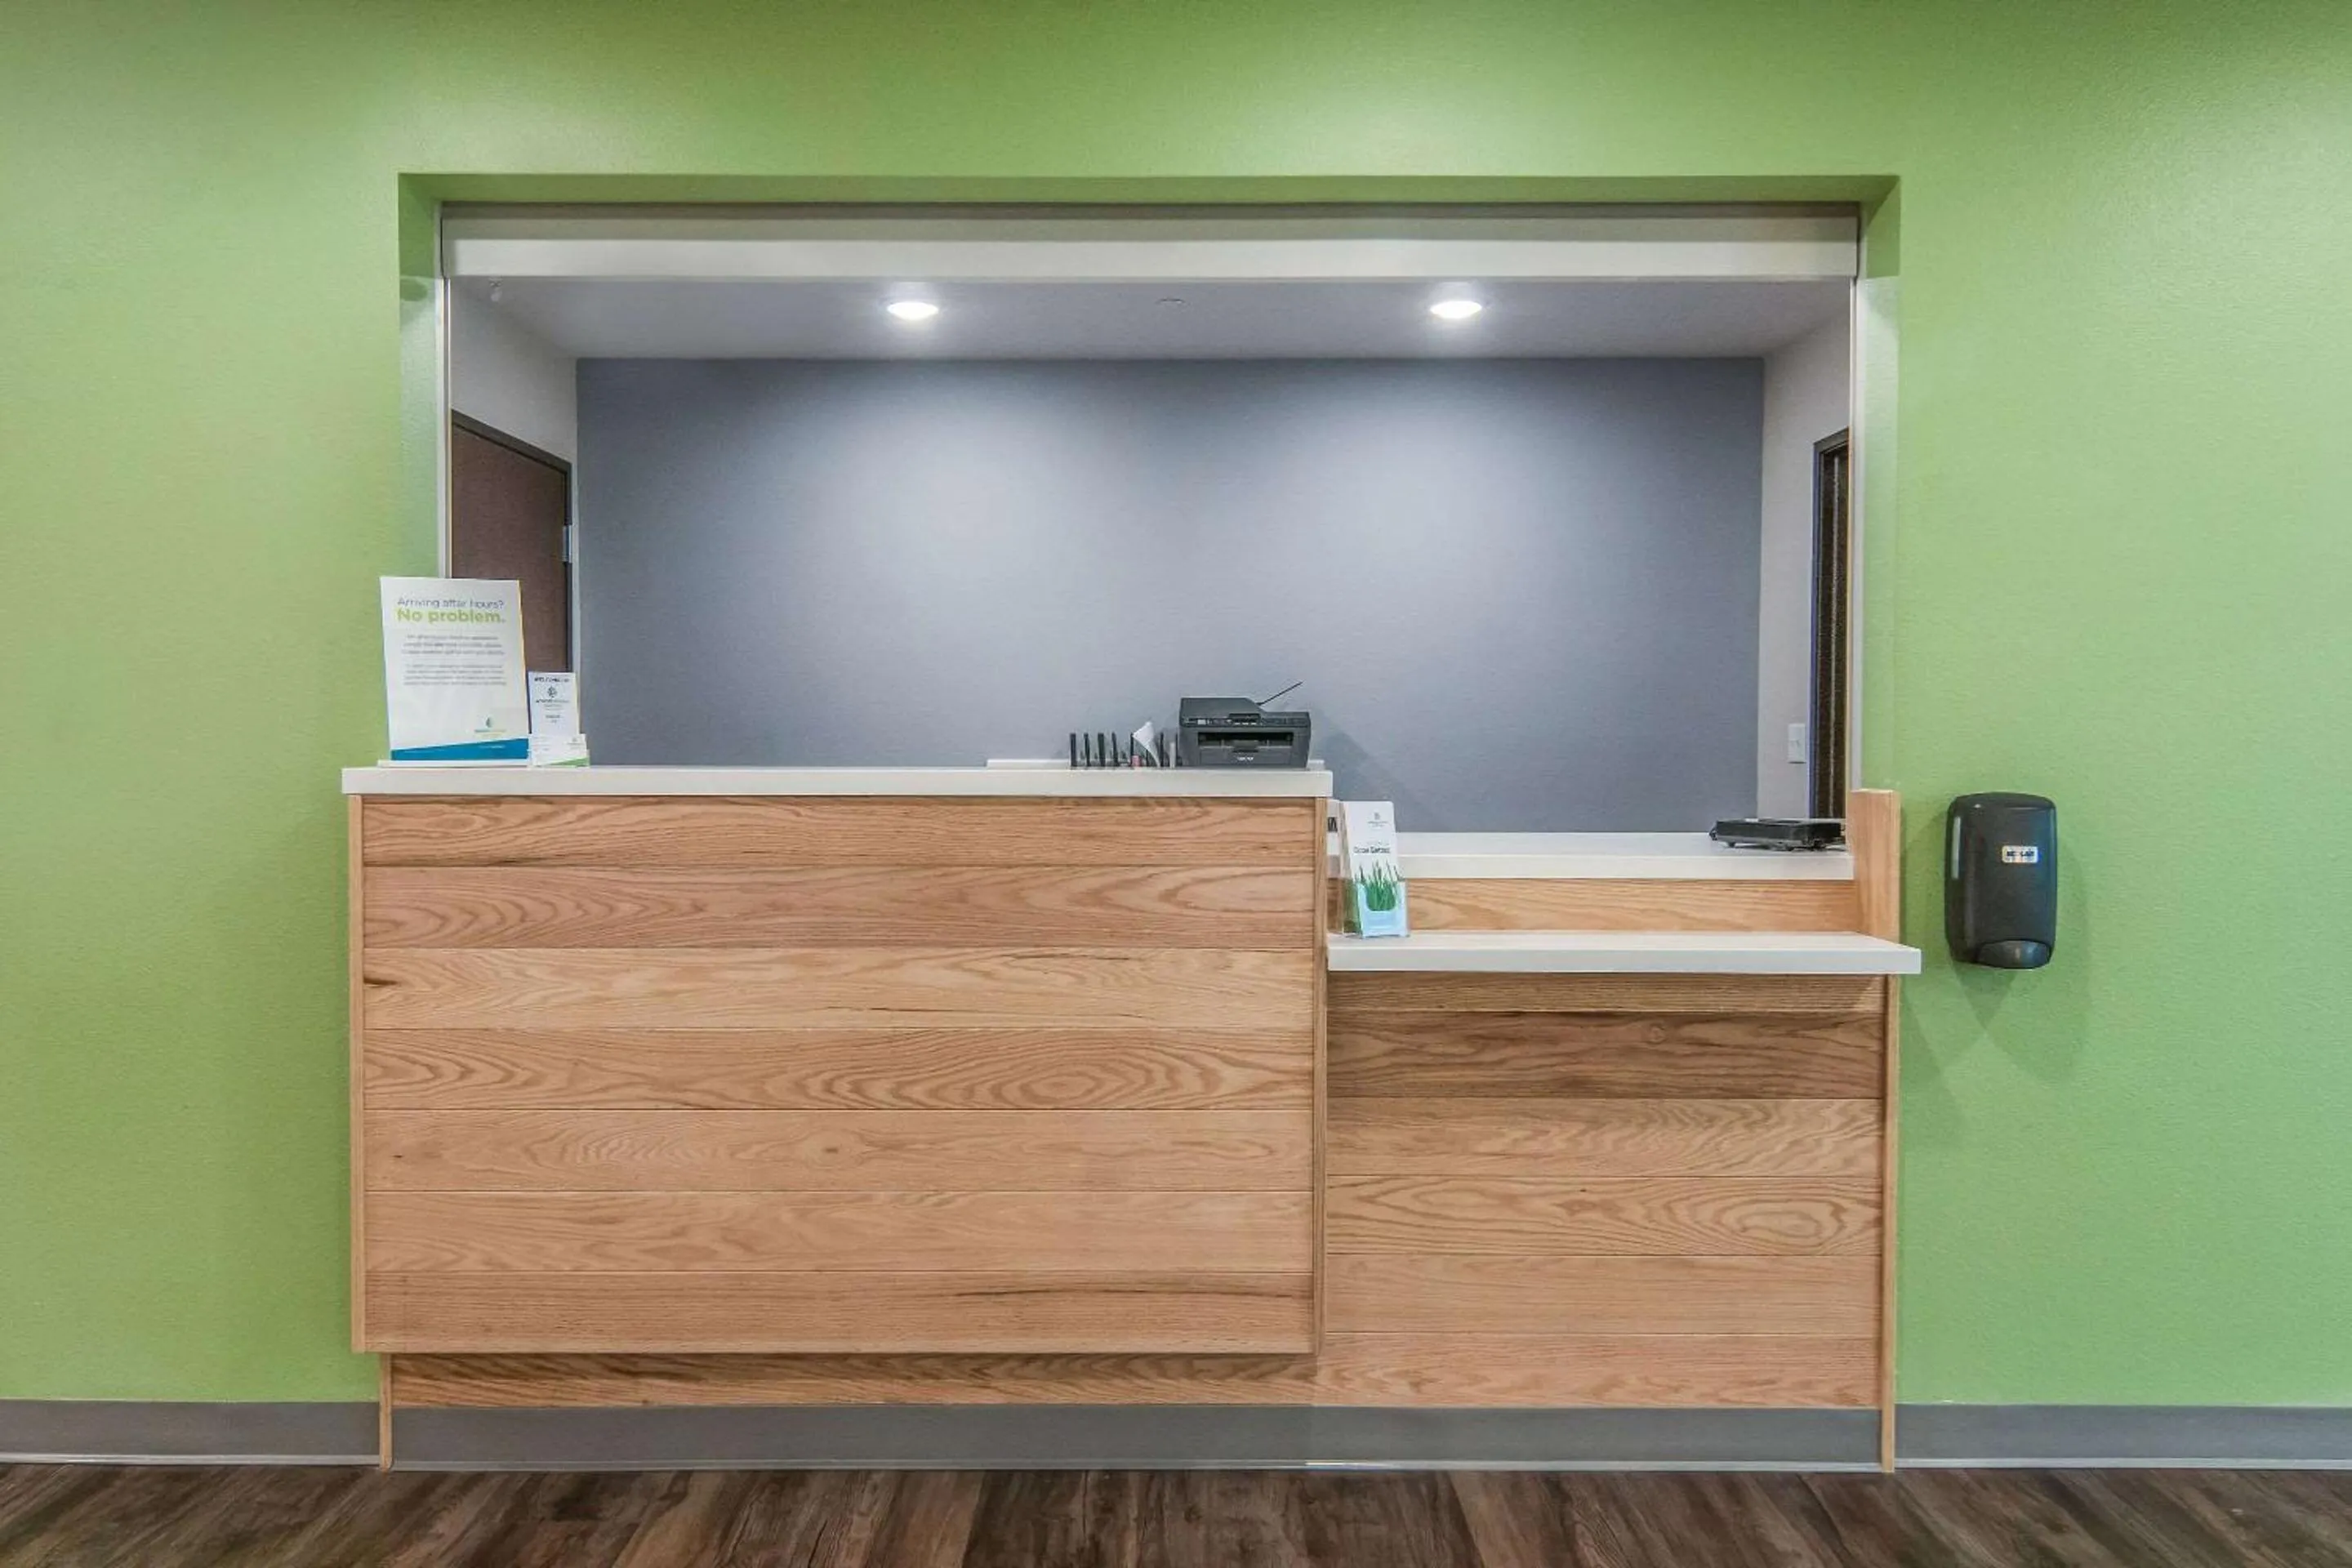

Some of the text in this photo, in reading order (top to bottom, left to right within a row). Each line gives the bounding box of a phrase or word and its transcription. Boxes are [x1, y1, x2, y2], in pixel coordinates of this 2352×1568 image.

[397, 597, 504, 609] Arriving after hours?
[397, 609, 506, 625] No problem.
